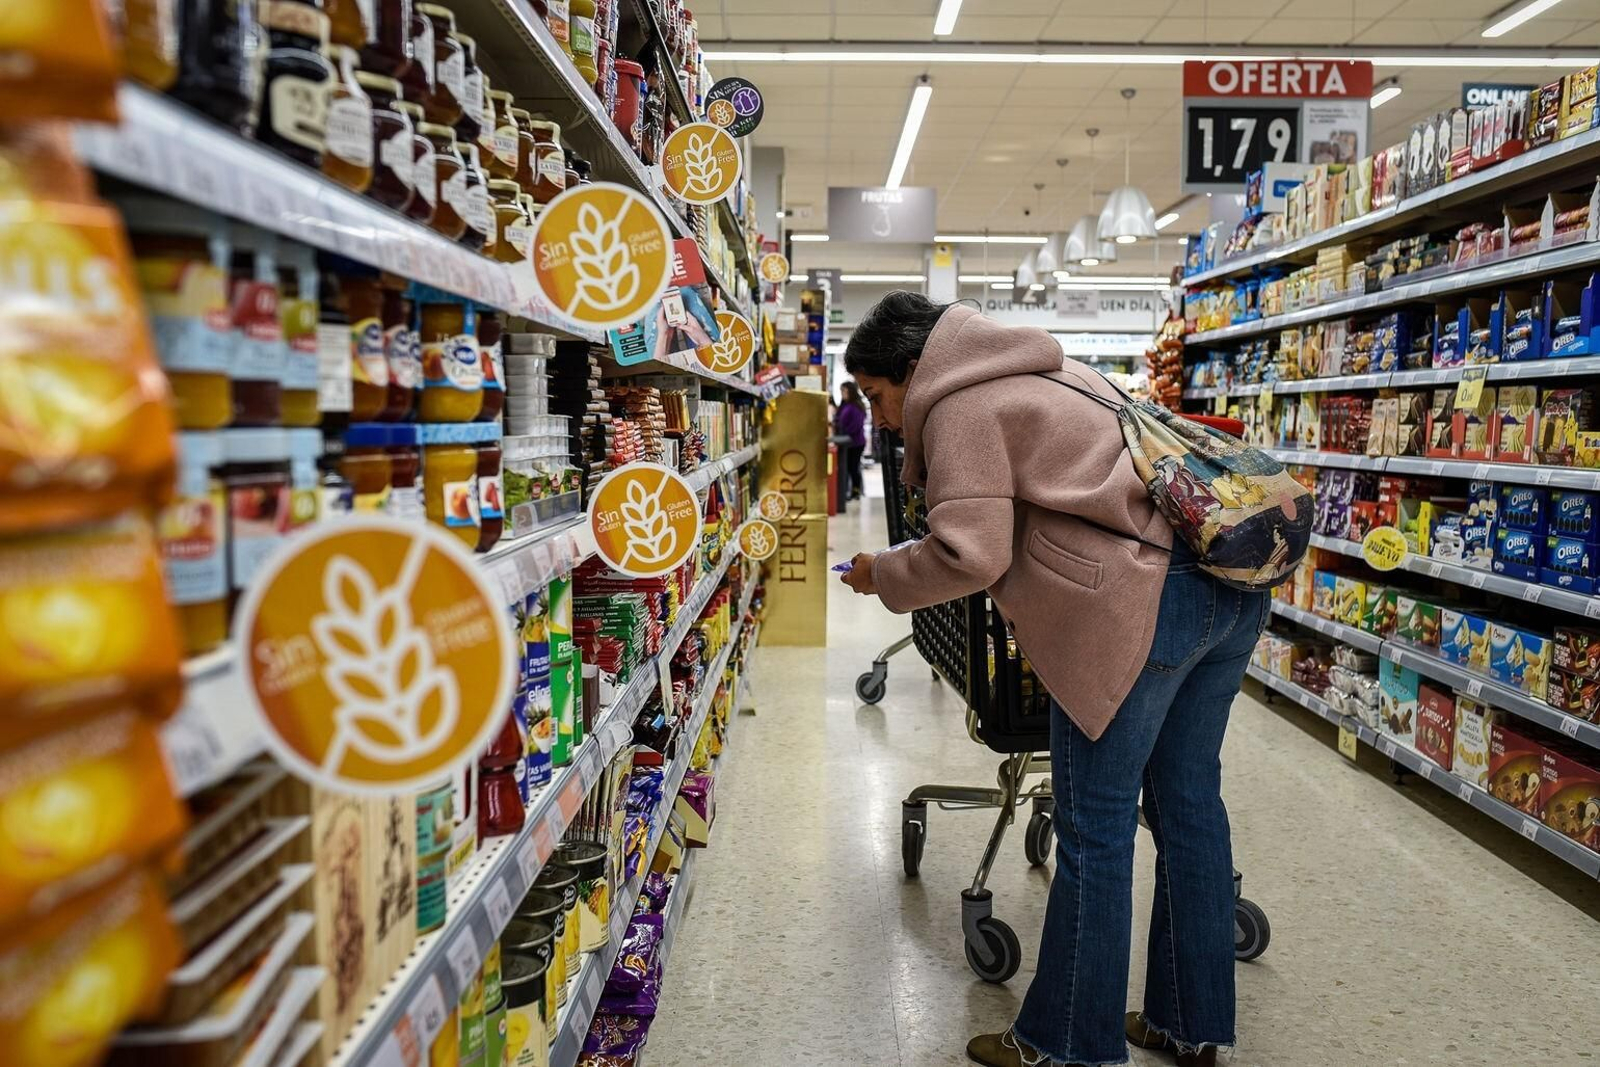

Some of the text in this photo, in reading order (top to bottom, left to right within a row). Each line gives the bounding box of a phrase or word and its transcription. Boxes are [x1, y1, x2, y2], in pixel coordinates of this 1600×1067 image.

[1208, 62, 1347, 94] OFERTA
[666, 154, 683, 165] Sin
[717, 154, 736, 164] Free
[539, 241, 569, 261] Sin
[629, 239, 662, 257] Free
[1509, 340, 1528, 356] OREO
[1553, 333, 1575, 350] OREO
[667, 499, 690, 511] Gluten
[1511, 492, 1533, 506] OREO
[1561, 498, 1585, 512] OREO
[597, 510, 620, 526] Sin
[668, 507, 693, 521] Free
[779, 449, 807, 584] FERRERO
[598, 521, 621, 533] Gluten
[1465, 527, 1488, 541] OREO
[1506, 537, 1529, 551] OREO
[1557, 546, 1581, 560] OREO
